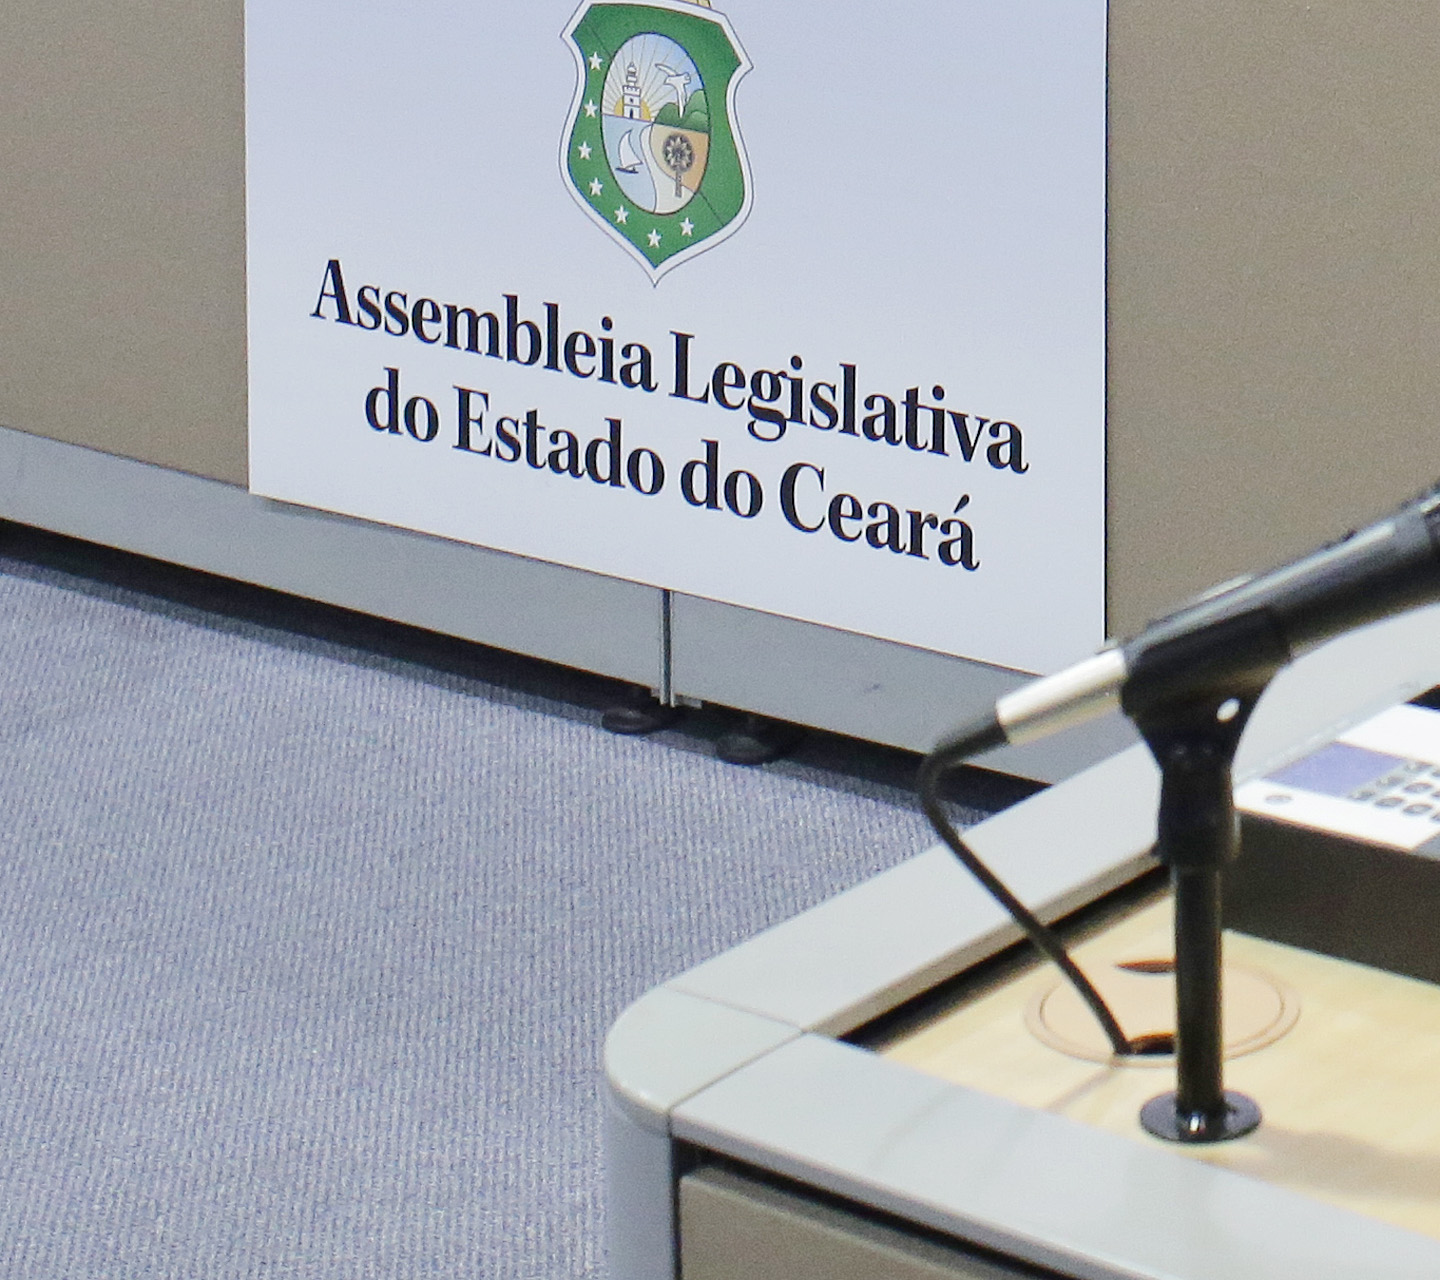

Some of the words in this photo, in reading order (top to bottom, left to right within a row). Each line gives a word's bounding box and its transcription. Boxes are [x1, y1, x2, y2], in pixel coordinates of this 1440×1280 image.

[312, 257, 659, 395] Assembleia
[669, 330, 1029, 475] Legislativa
[364, 368, 439, 443] do
[453, 385, 665, 496] Estado
[681, 440, 762, 520] do
[780, 463, 981, 572] Ceará
